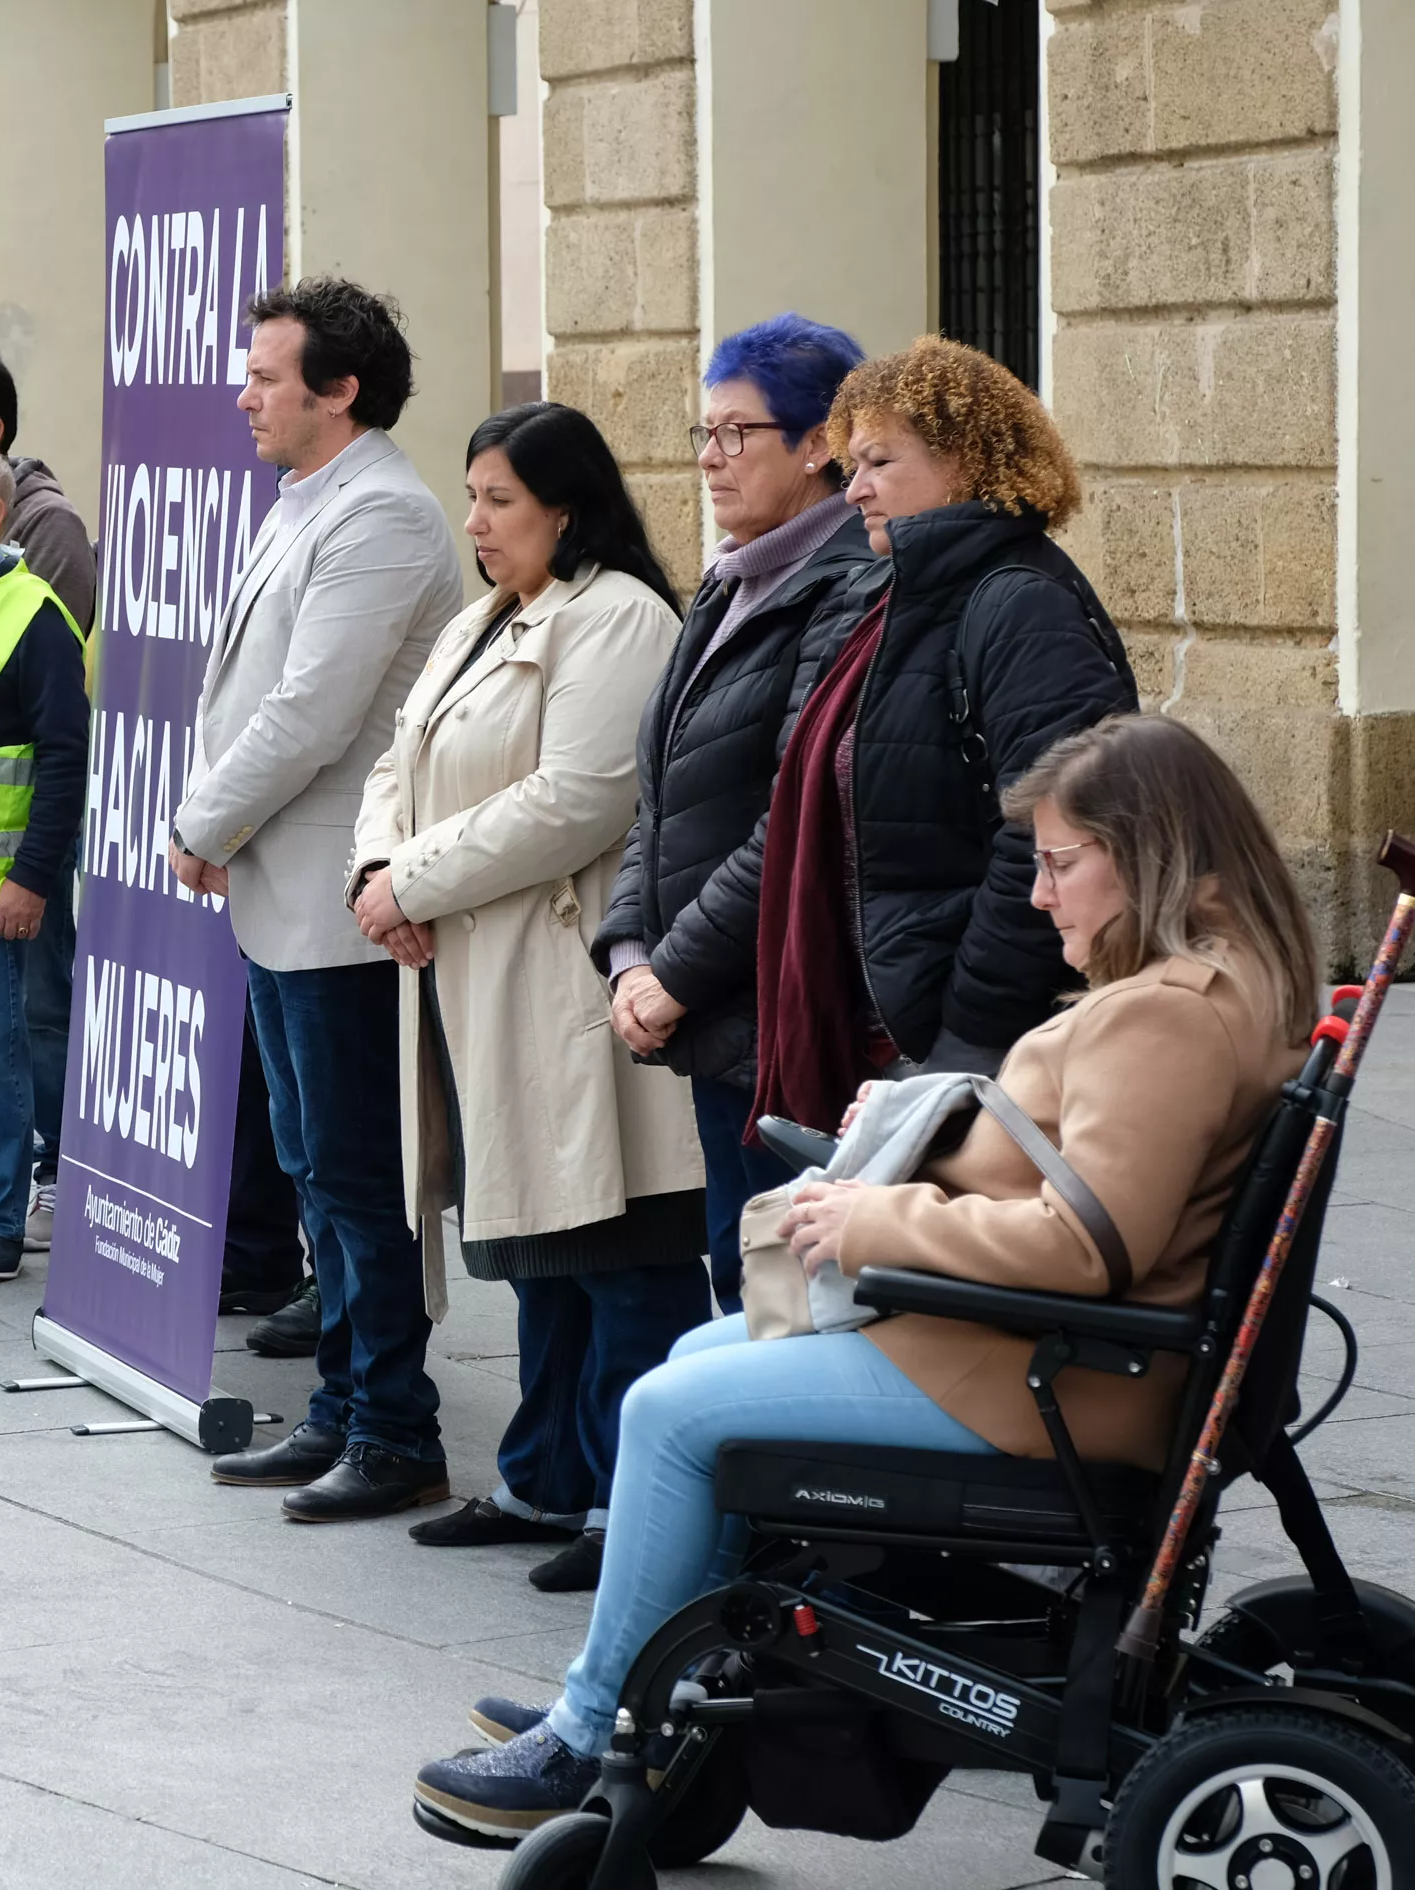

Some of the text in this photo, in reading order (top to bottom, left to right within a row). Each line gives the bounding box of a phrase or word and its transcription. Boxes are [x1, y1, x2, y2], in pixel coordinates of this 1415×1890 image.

[110, 208, 219, 387] CONTRA
[101, 463, 252, 647] VIOLENCIA
[84, 709, 171, 895] HACIA
[79, 955, 205, 1169] MUJERES
[84, 1184, 181, 1264] Ayuntamiento de Cádiz
[95, 1235, 165, 1287] Fundación Municipal de la Mujer
[891, 1652, 1021, 1720] KITTOS
[939, 1703, 1011, 1737] COUNTRY
